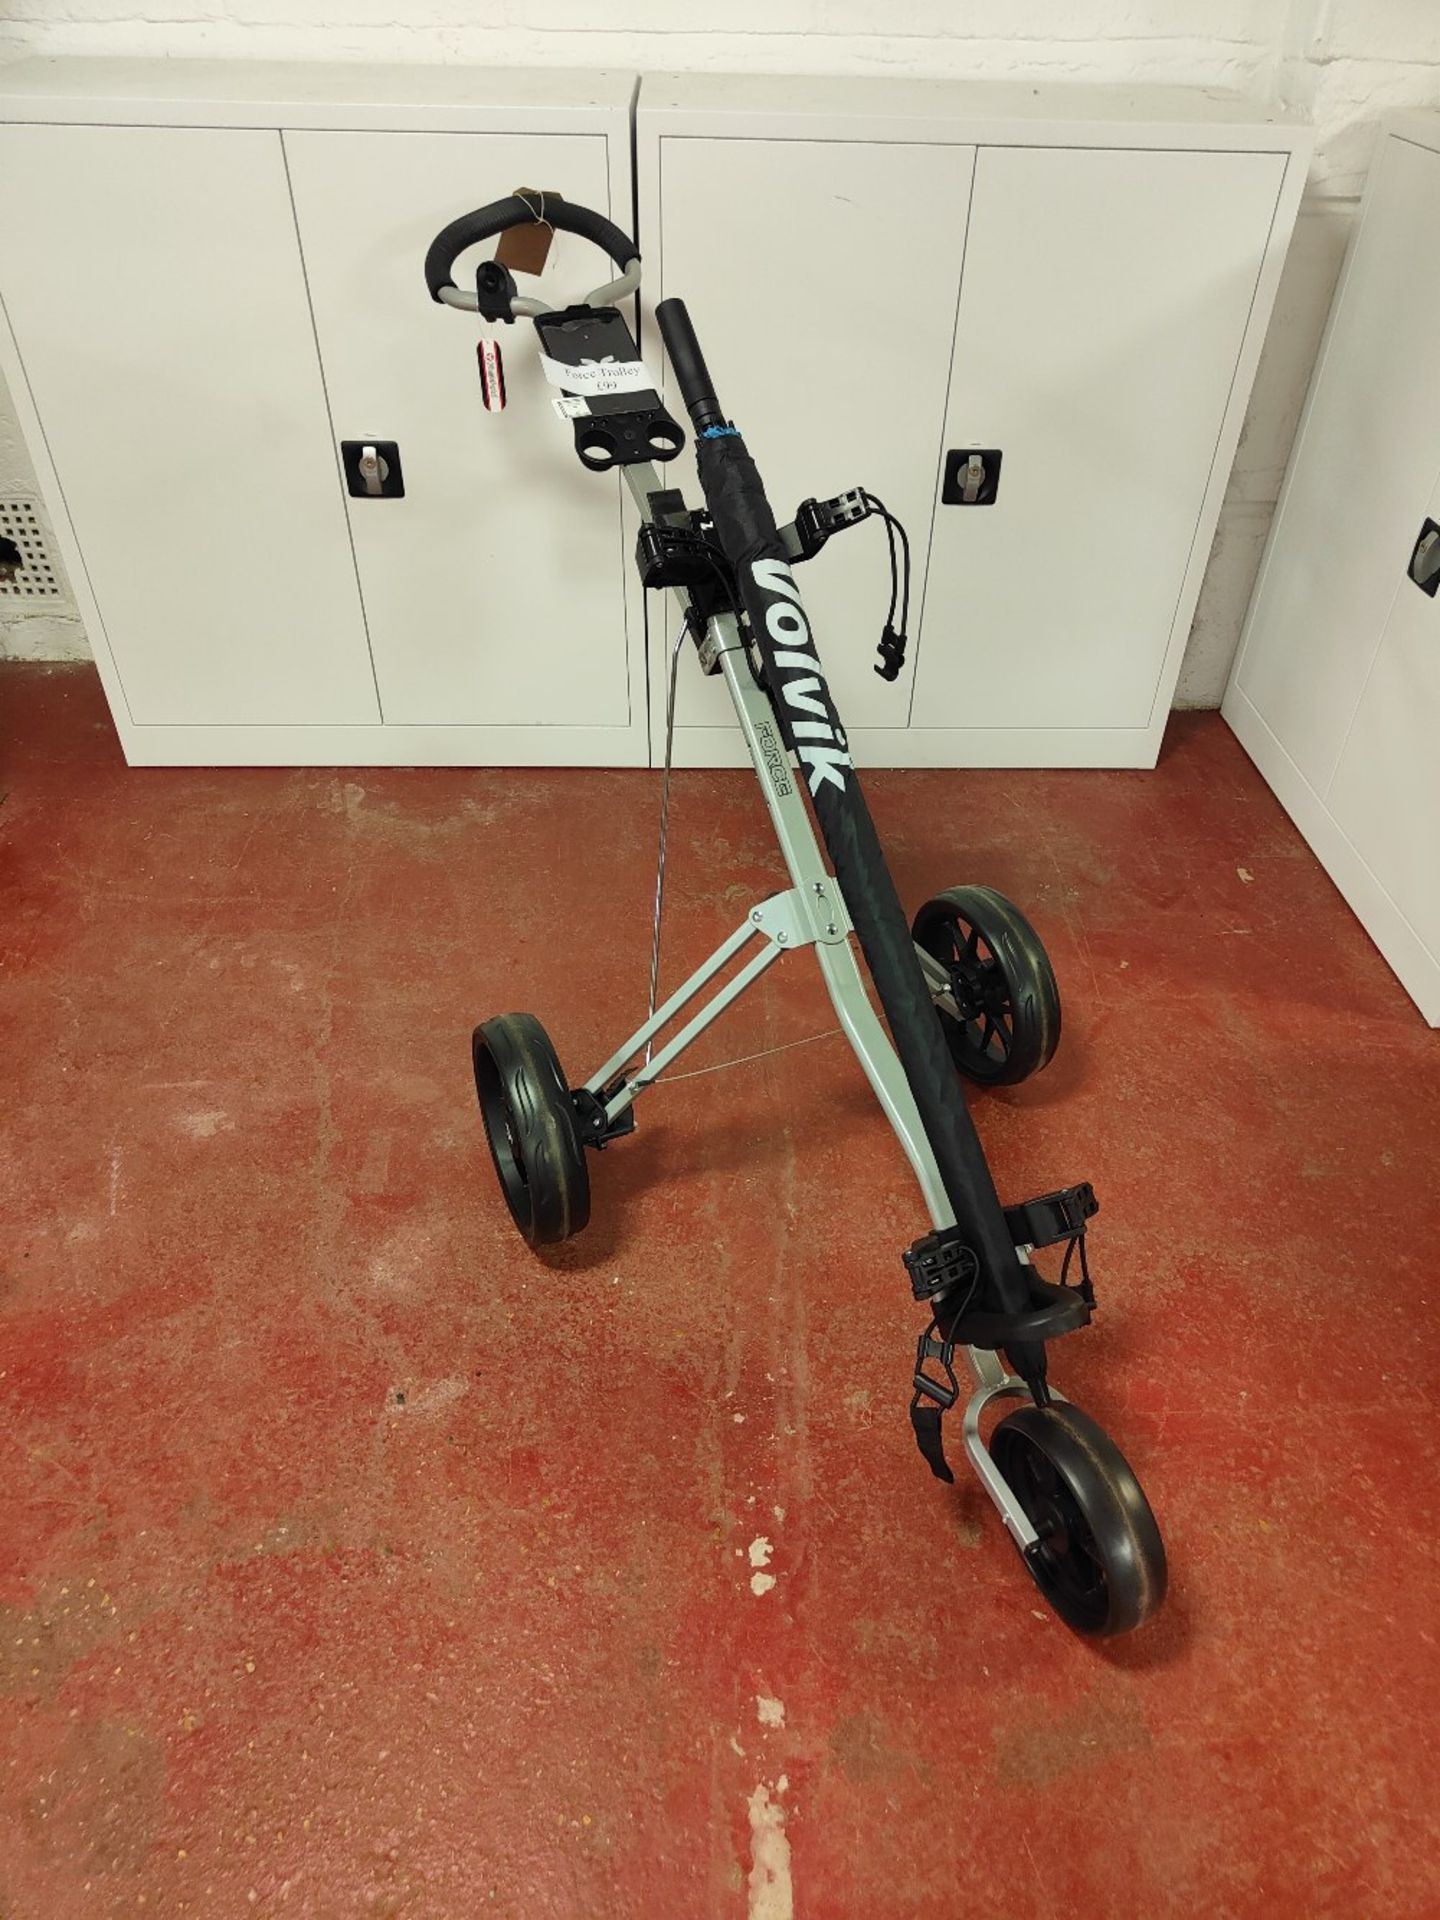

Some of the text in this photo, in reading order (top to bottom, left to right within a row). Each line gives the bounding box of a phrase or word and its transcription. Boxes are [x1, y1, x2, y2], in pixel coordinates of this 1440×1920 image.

[564, 366, 641, 380] Force Trolley
[754, 720, 792, 797] FORCE
